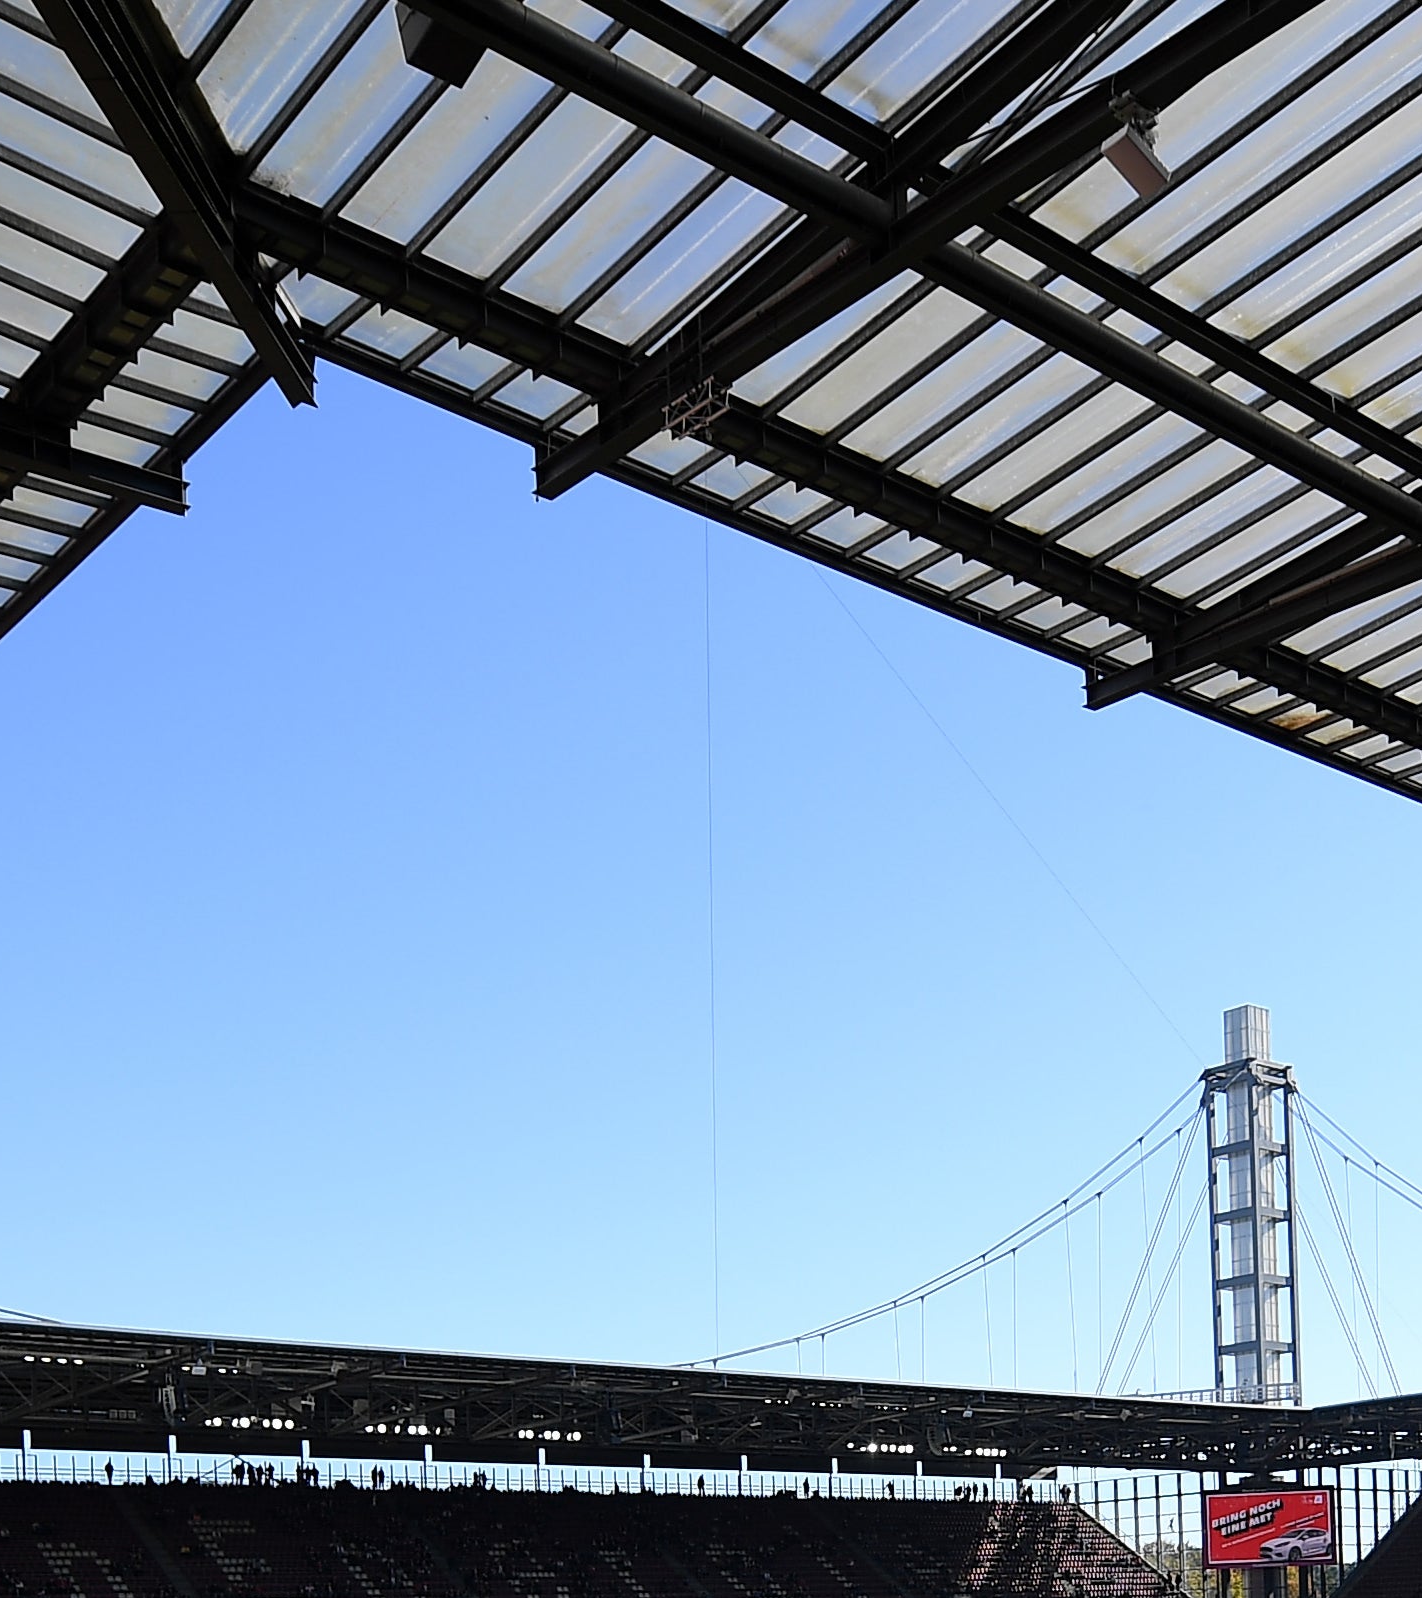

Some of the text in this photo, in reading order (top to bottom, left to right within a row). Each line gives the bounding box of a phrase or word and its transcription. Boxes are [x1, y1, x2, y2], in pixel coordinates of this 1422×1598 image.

[1212, 1499, 1280, 1528] BRING NOCH
[1221, 1520, 1246, 1535] EINE
